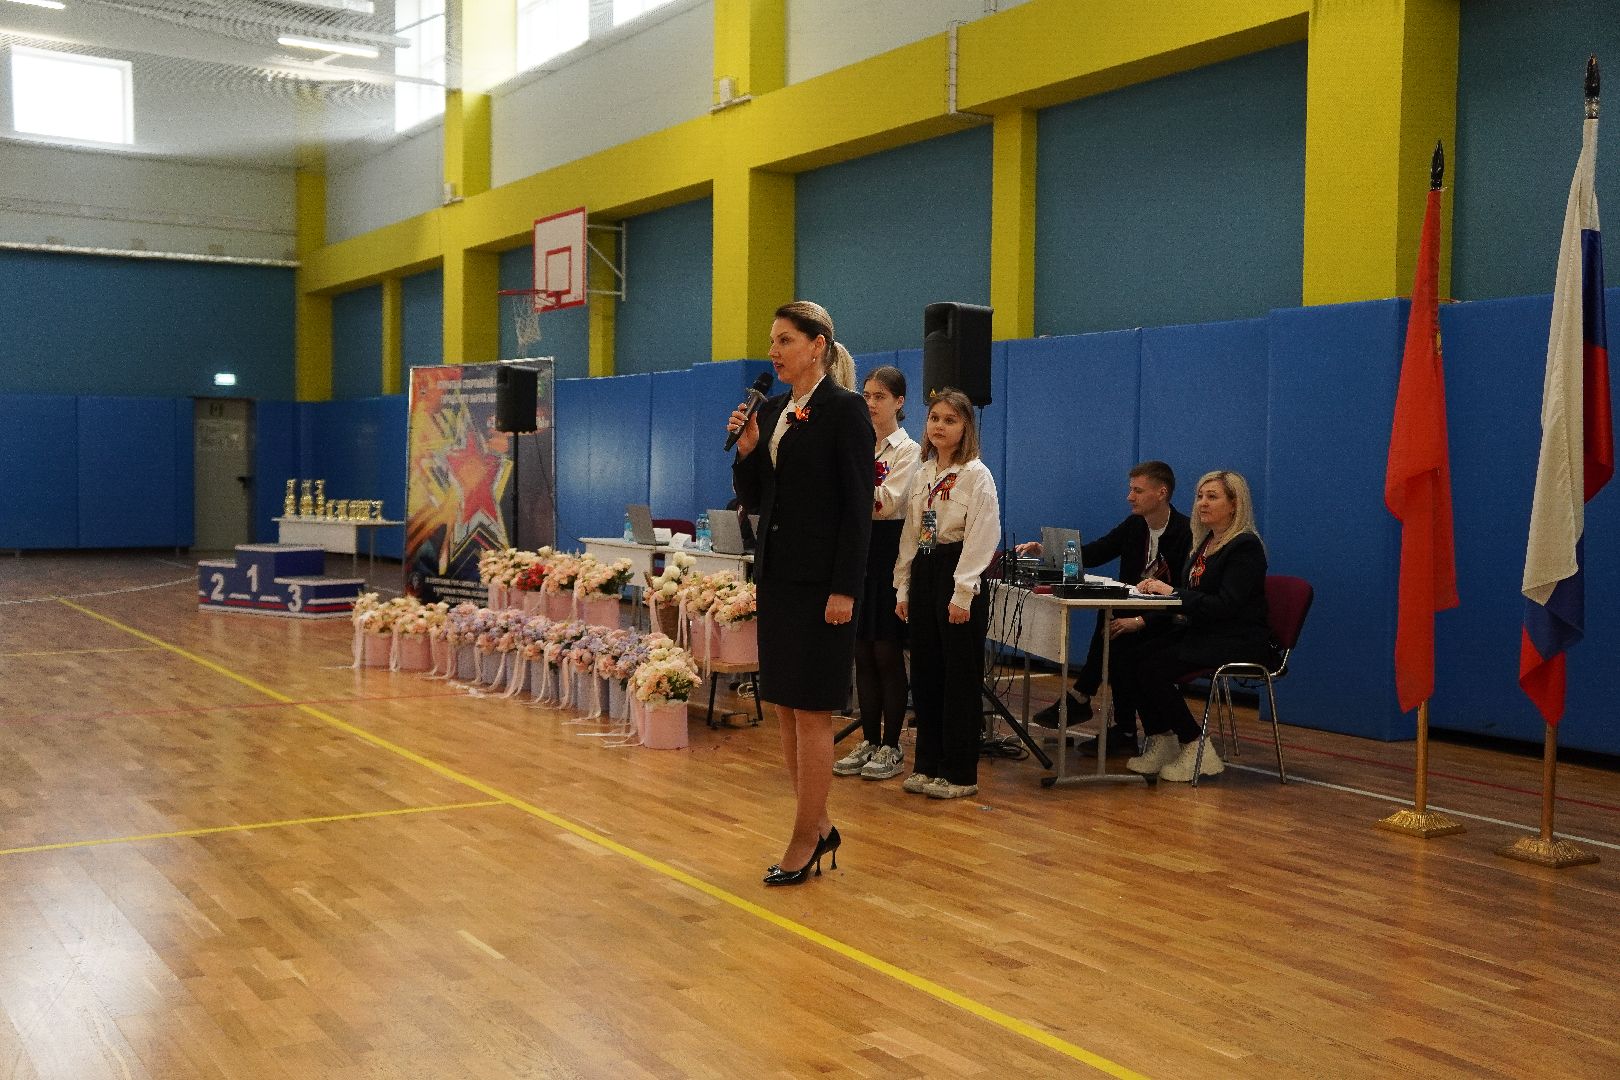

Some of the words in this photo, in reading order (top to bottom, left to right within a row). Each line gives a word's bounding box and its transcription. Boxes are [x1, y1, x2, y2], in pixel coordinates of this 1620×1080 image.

[210, 572, 224, 600] 2
[246, 564, 258, 592] 1
[287, 584, 302, 612] 3
